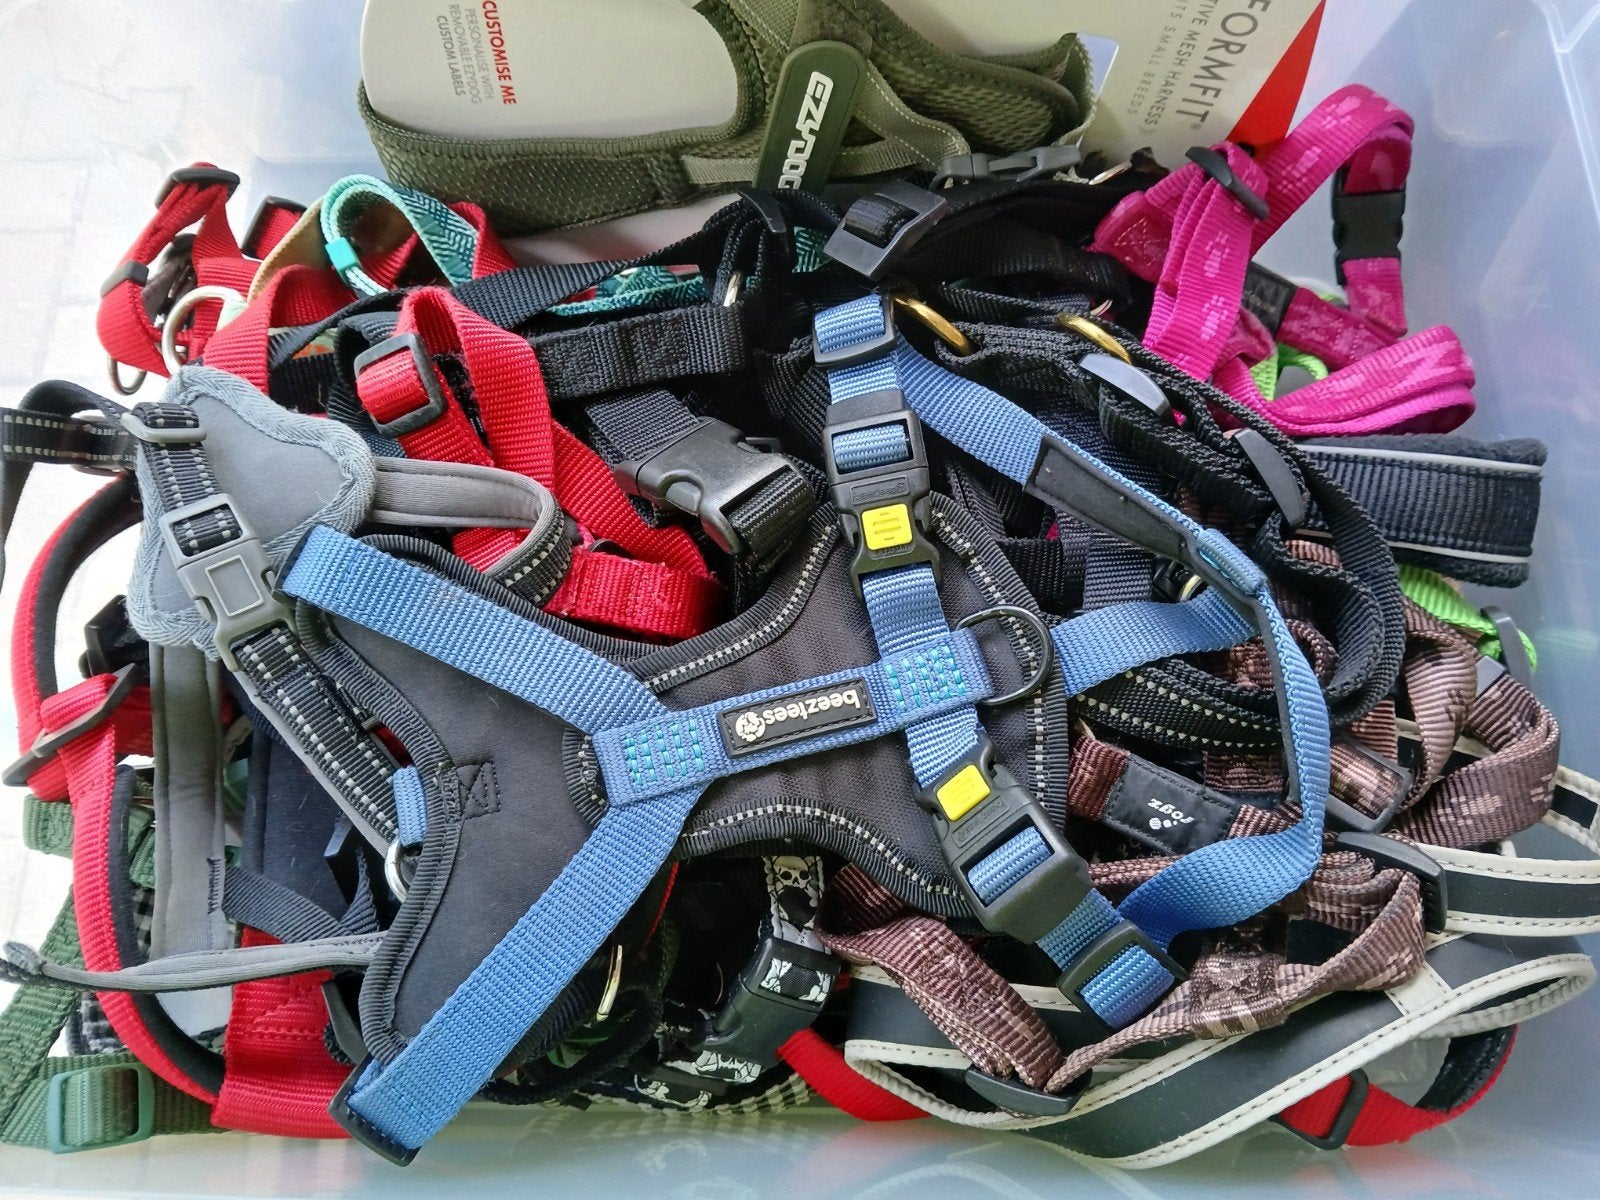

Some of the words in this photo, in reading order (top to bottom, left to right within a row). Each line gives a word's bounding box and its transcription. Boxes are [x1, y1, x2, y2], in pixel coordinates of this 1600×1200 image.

[436, 15, 456, 60] CUSTOM
[448, 62, 466, 96] LABELS
[449, 4, 473, 62] REMOVABLE
[463, 64, 482, 104] EZYDOG
[482, 0, 512, 81] CUSTOMISE
[500, 85, 517, 105] ME
[1148, 25, 1177, 65] SMALL
[1172, 29, 1201, 67] MESH
[480, 74, 496, 99] WITH
[1126, 71, 1155, 115] BREEDS
[1144, 70, 1182, 126] HARNESS
[762, 689, 861, 725] beeztees
[1147, 798, 1195, 824] rogz
